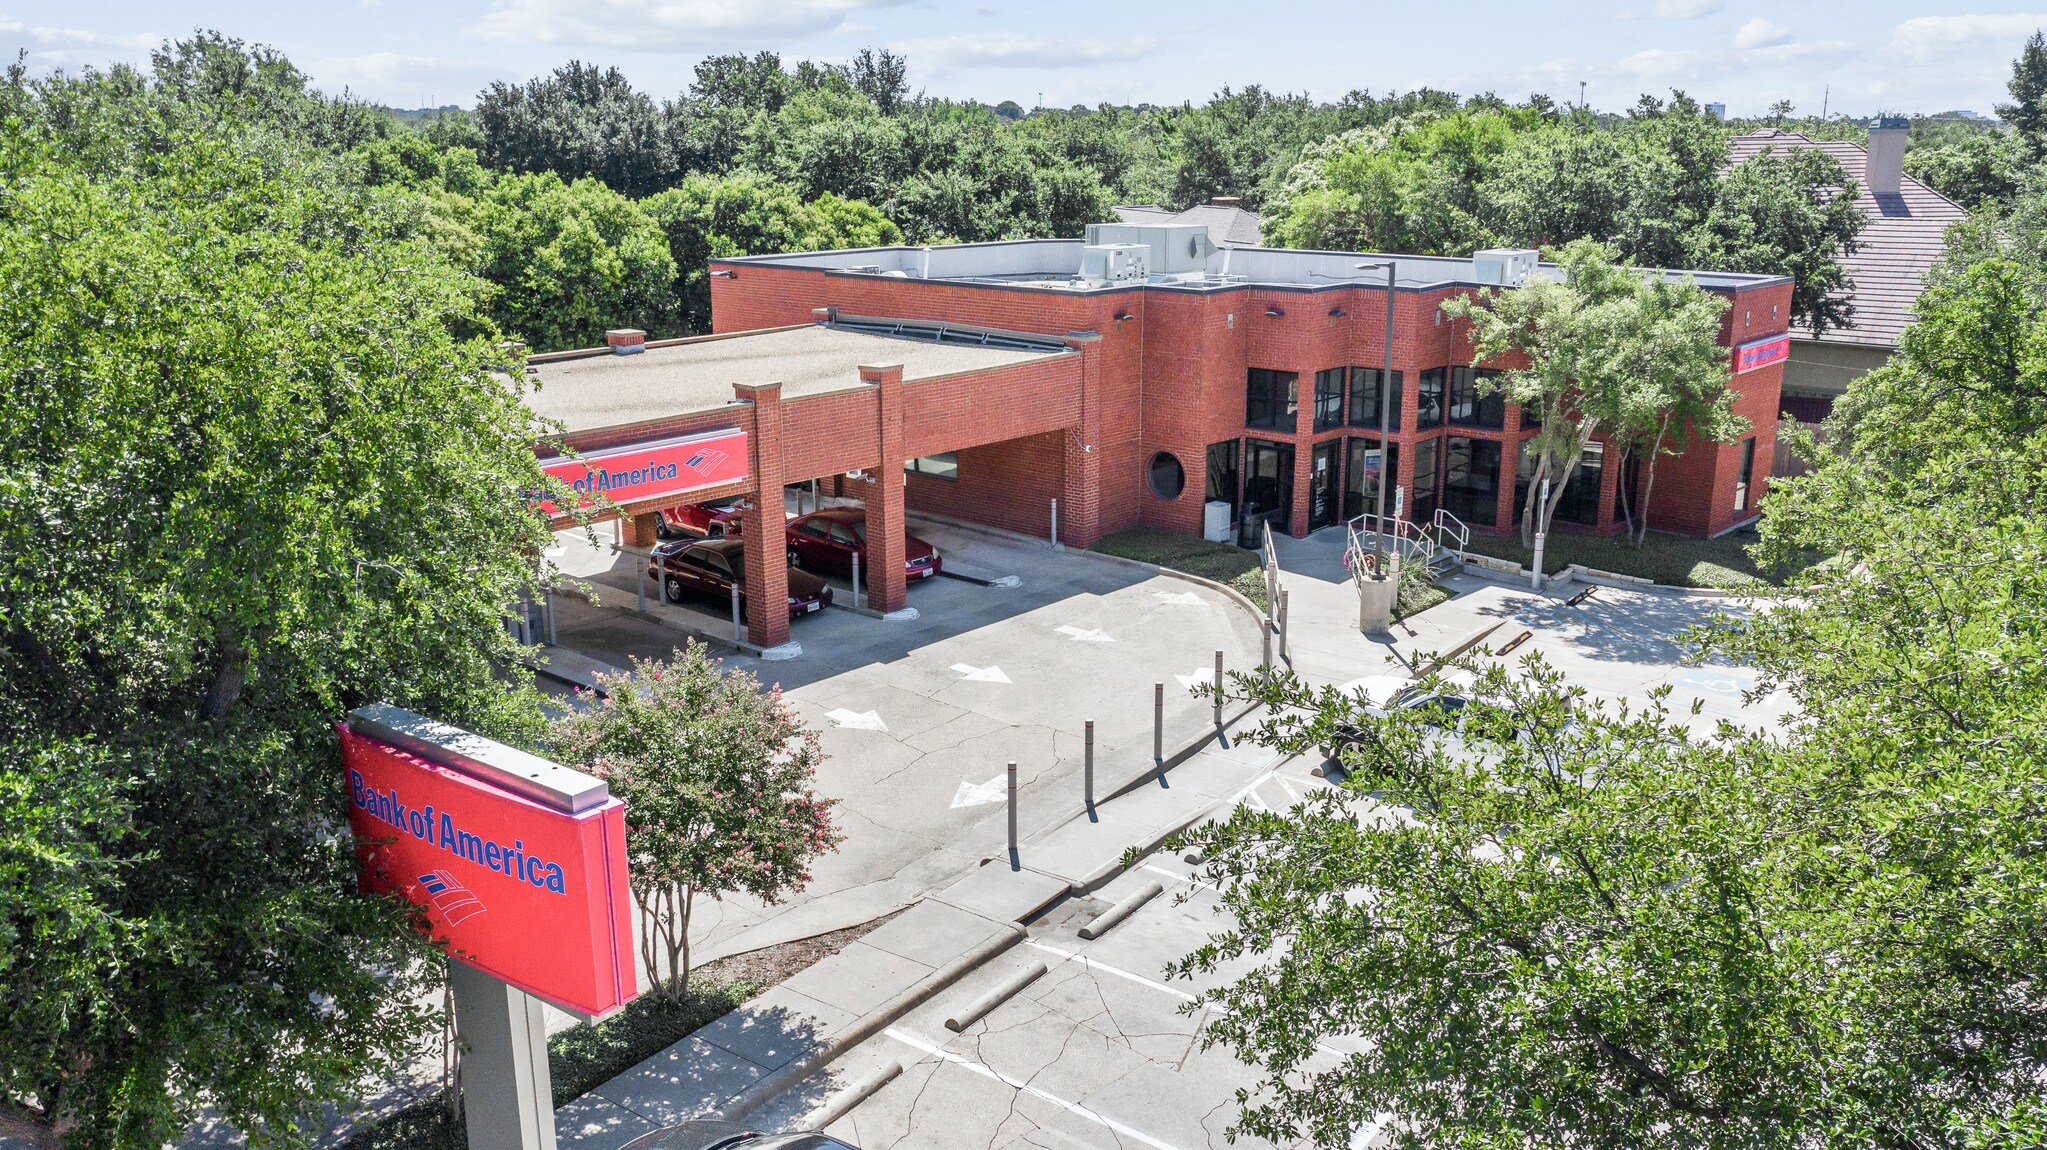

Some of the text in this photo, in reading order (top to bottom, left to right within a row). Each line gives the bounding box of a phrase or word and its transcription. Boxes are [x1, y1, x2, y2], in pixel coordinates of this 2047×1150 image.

[573, 470, 595, 495] of
[597, 460, 677, 493] America
[350, 768, 566, 896] Bank of America
